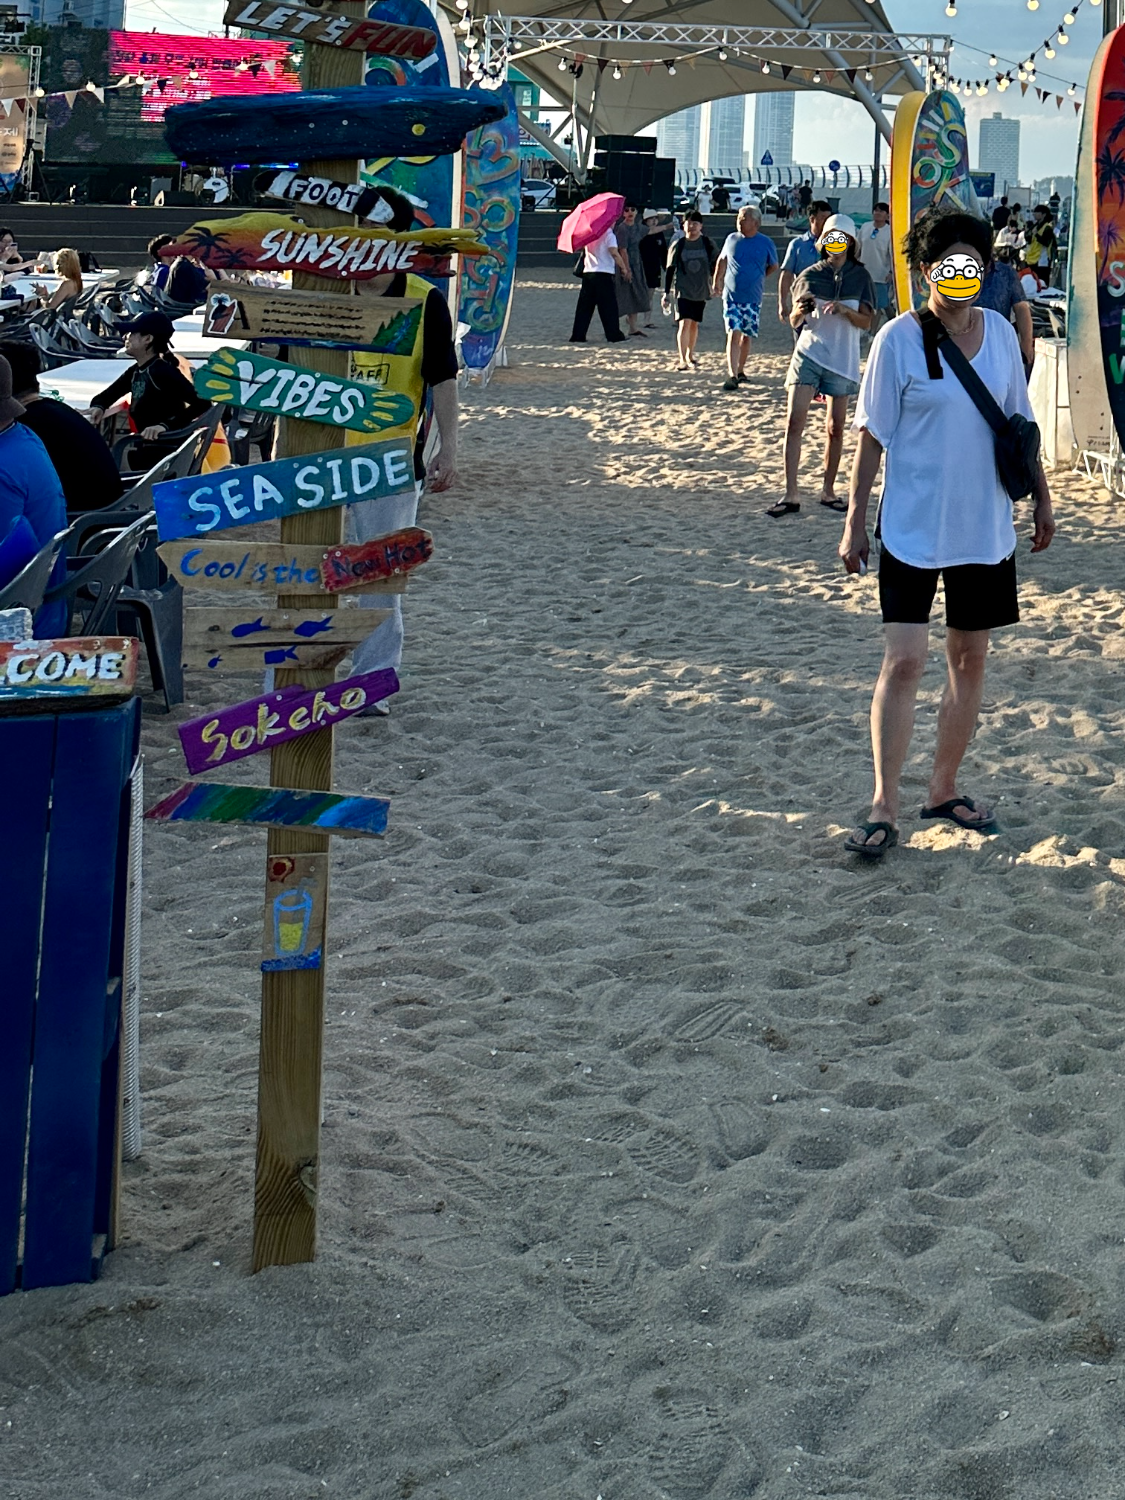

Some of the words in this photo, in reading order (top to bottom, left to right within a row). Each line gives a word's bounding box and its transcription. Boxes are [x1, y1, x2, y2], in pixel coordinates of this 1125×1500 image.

[234, 1, 354, 44] LET'S
[341, 21, 437, 57] FUN
[256, 228, 422, 272] SUNSHINE
[237, 361, 365, 423] VIBES
[188, 475, 283, 531] SEA
[294, 450, 409, 508] SIDE
[180, 549, 250, 579] Cool
[273, 558, 320, 584] the
[202, 688, 366, 763] Sokcho
